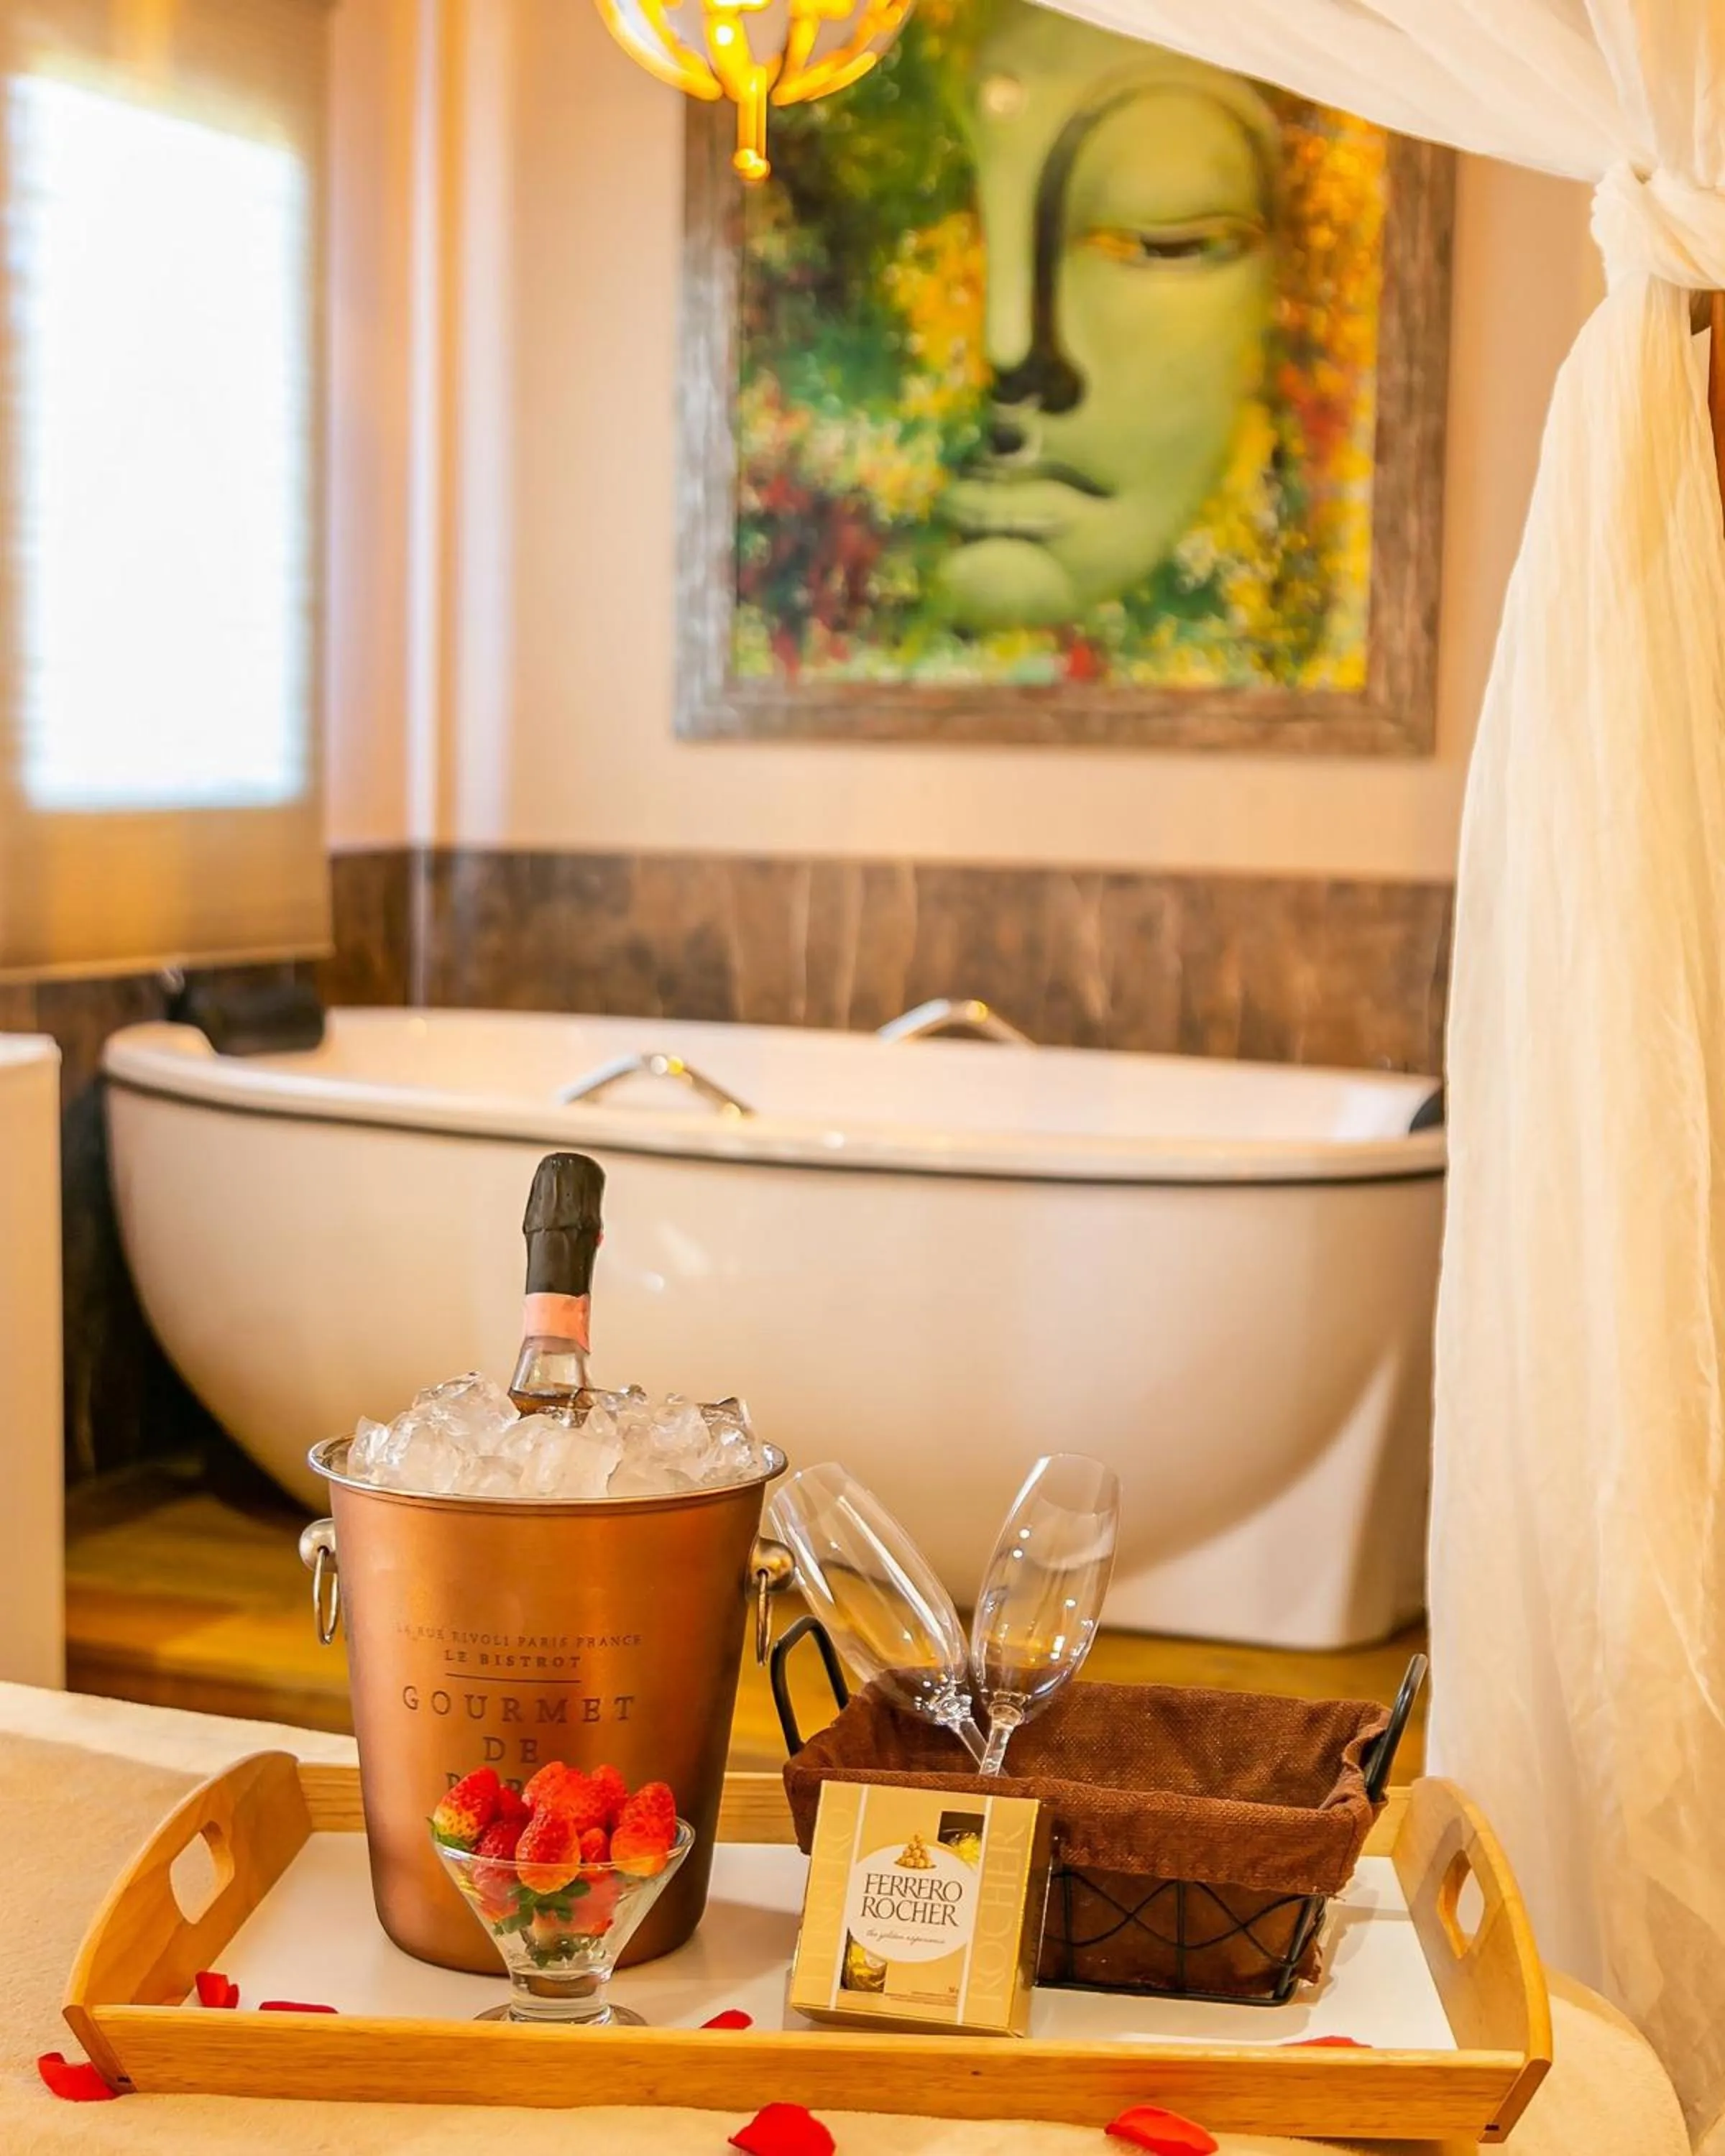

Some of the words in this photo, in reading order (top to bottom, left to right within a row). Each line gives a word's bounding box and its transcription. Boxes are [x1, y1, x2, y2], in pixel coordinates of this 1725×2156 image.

[418, 1626, 444, 1640] RUE
[451, 1631, 509, 1647] RIVOLI
[518, 1636, 568, 1648] PARIS
[576, 1634, 643, 1648] FRANCE
[445, 1649, 467, 1663] LE
[480, 1654, 581, 1669] BISTROT
[402, 1685, 635, 1725] GOURMET
[483, 1736, 539, 1764] DE
[863, 1873, 962, 1902] FERRERO
[860, 1896, 959, 1927] ROCHER
